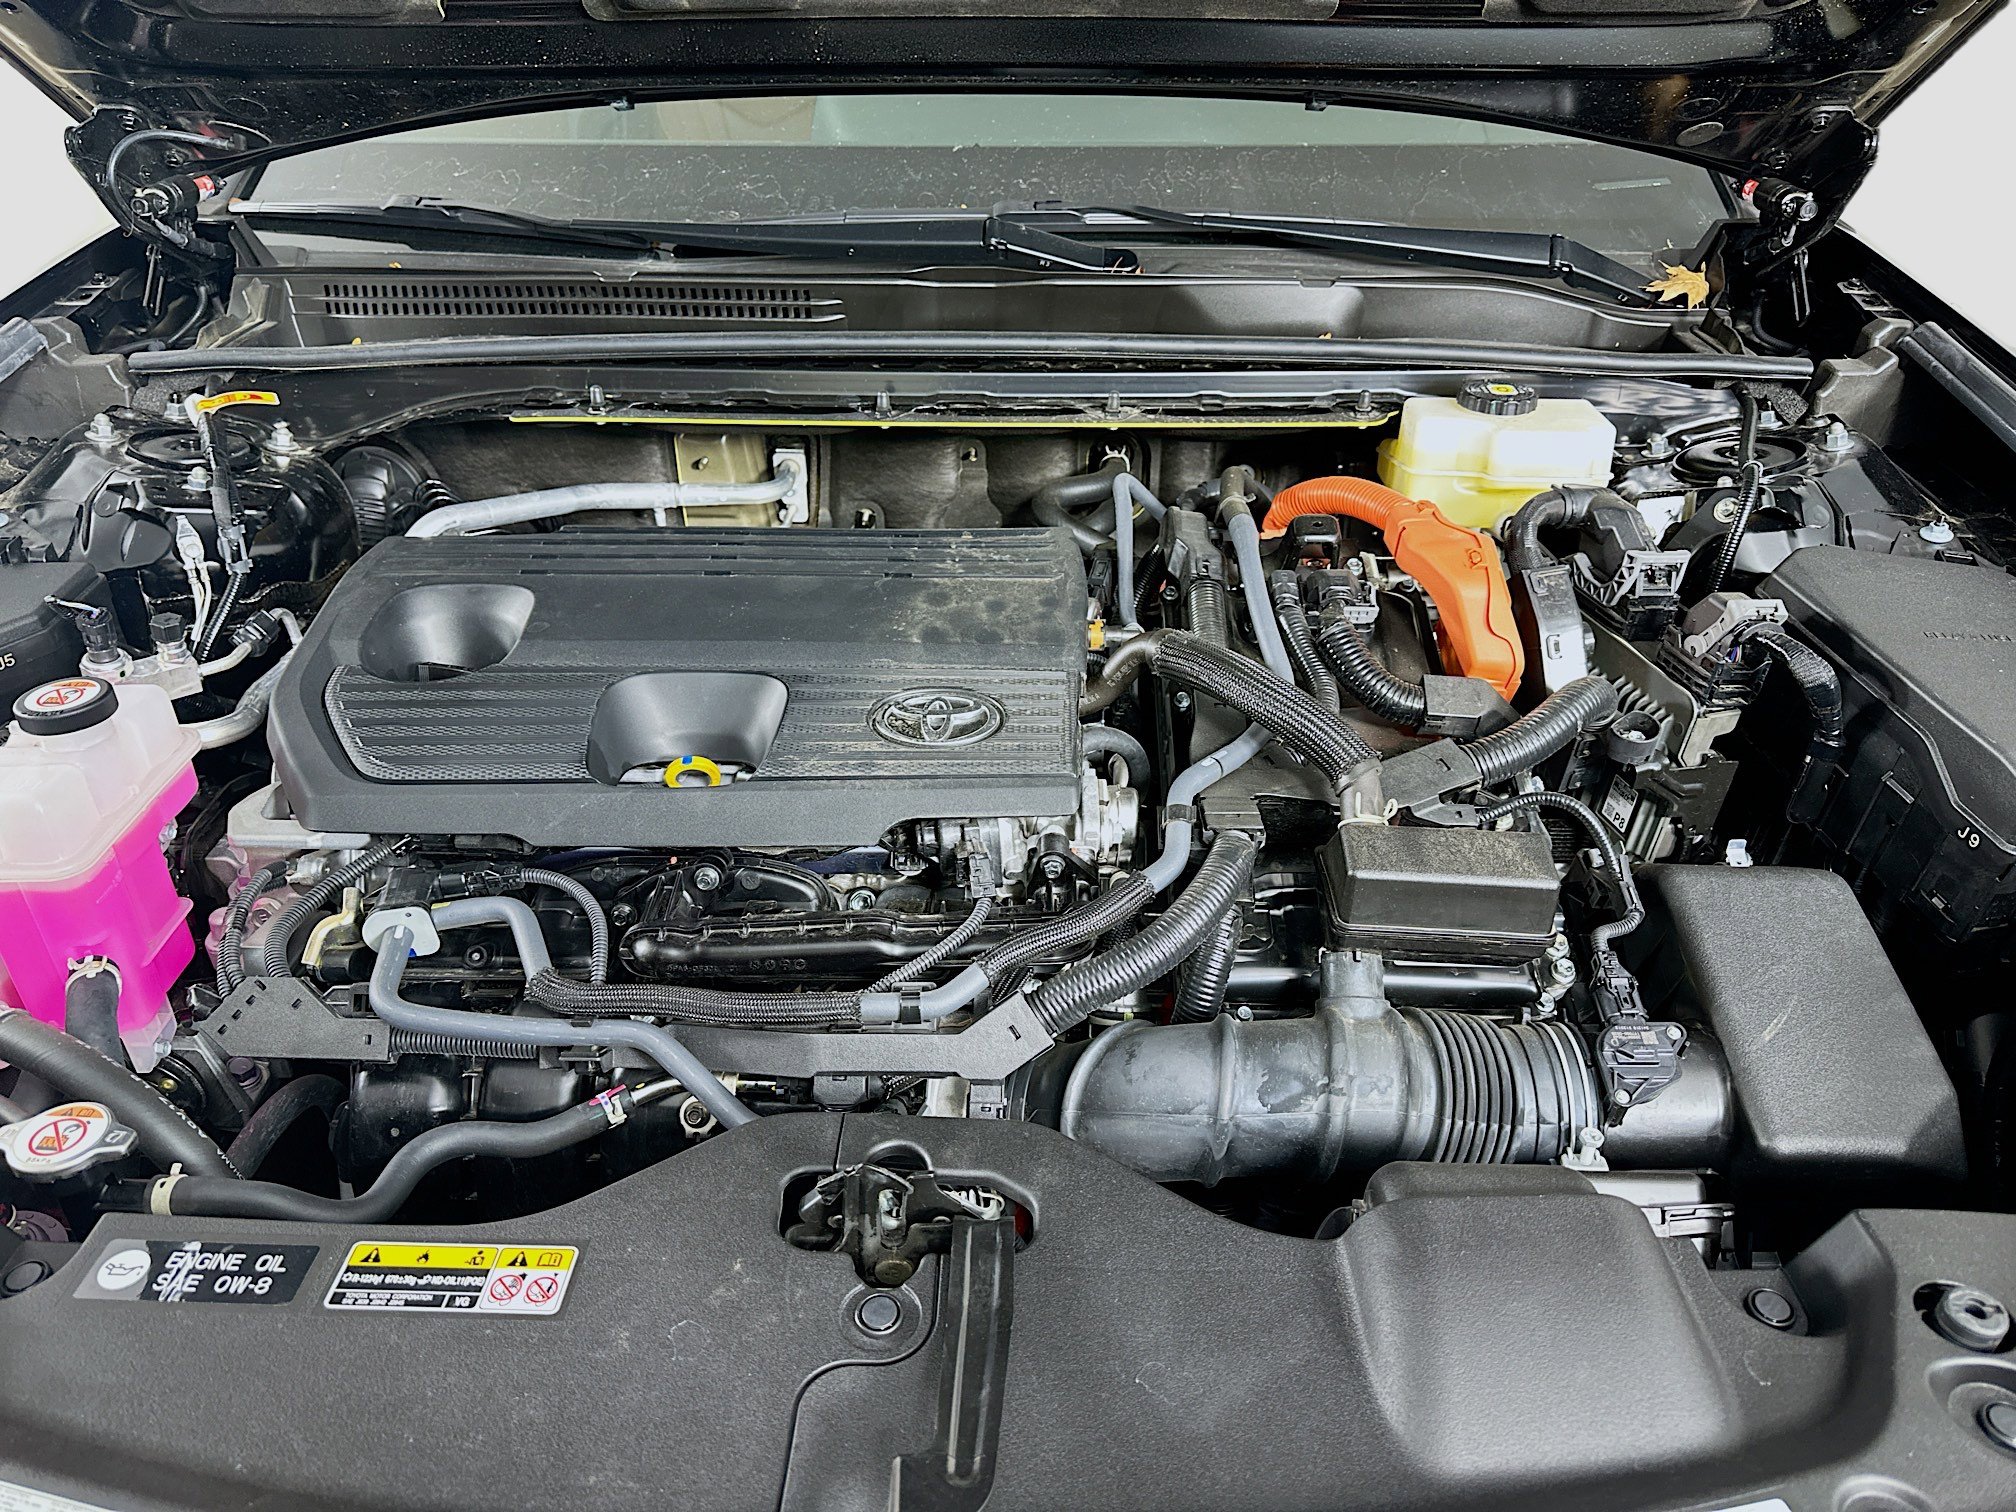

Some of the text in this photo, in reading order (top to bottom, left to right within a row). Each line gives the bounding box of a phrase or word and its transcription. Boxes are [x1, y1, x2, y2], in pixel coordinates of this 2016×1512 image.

[1613, 812, 1625, 828] P8
[1957, 826, 1980, 848] J9
[164, 1251, 287, 1272] ENGINE OIL
[152, 1273, 204, 1293] SAE
[369, 1292, 392, 1300] MOTOR
[391, 1293, 434, 1301] CORPORATION
[455, 1296, 470, 1307] VG
